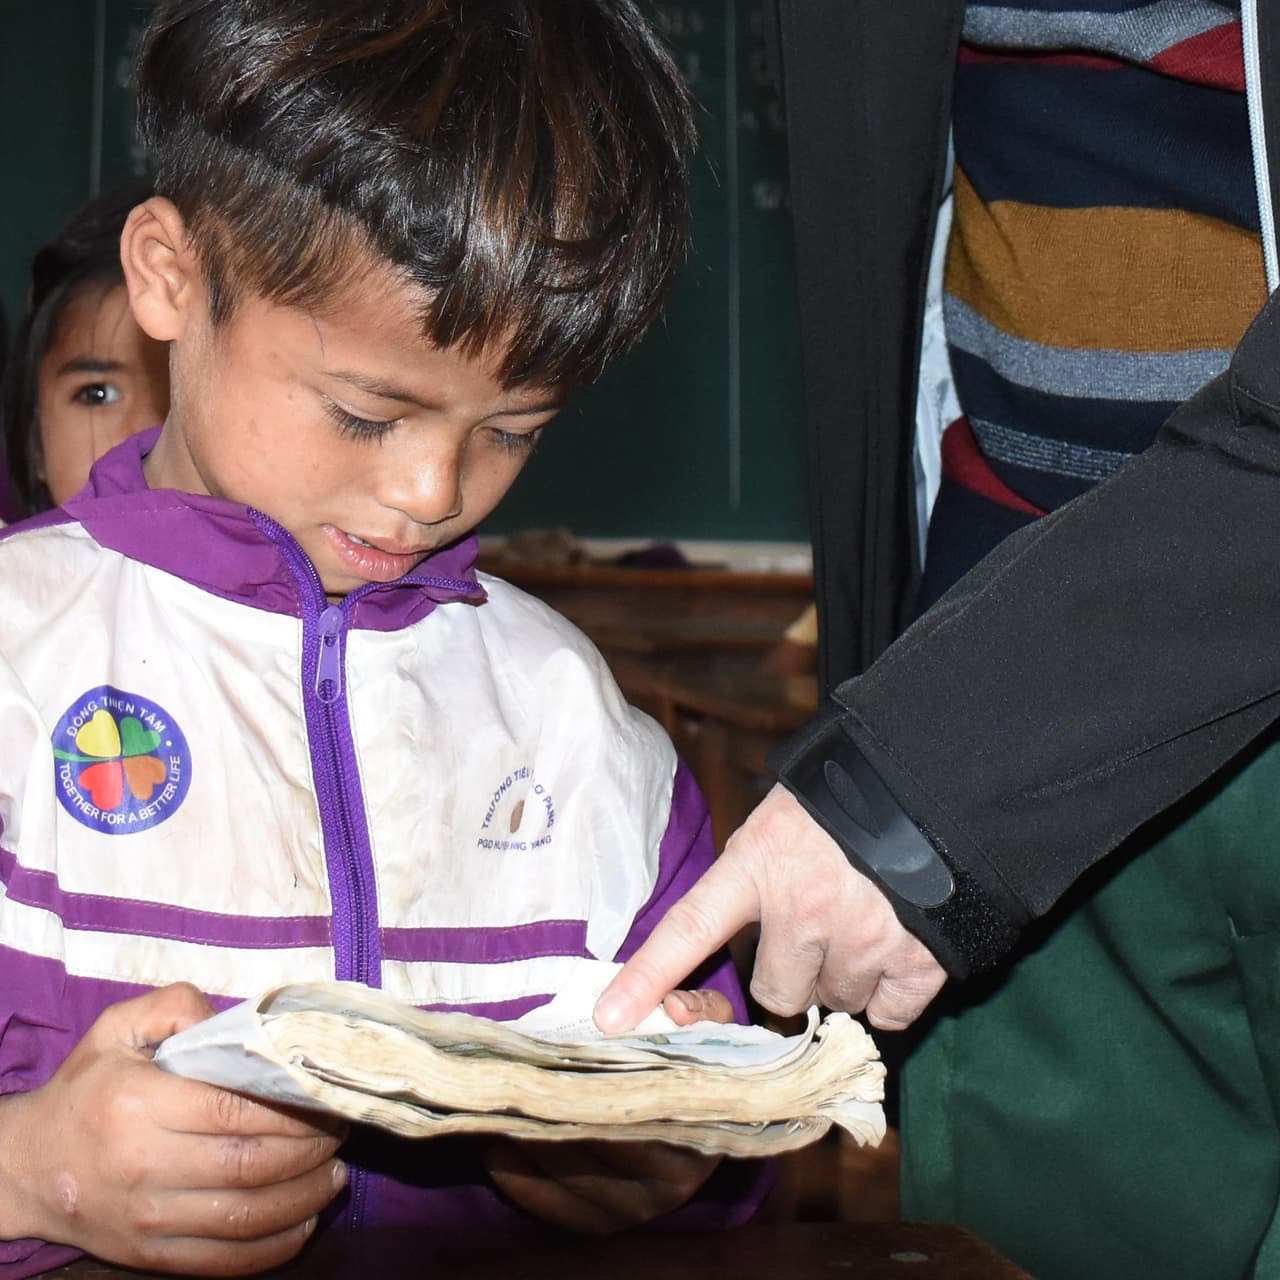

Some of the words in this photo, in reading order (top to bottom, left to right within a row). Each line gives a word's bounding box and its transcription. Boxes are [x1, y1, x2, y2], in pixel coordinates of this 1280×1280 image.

[60, 764, 100, 820] TOGETHER
[101, 811, 126, 825] FOR
[128, 814, 138, 824] A
[139, 784, 178, 820] BETTER
[169, 755, 181, 783] LIFE
[530, 834, 552, 849] YANG
